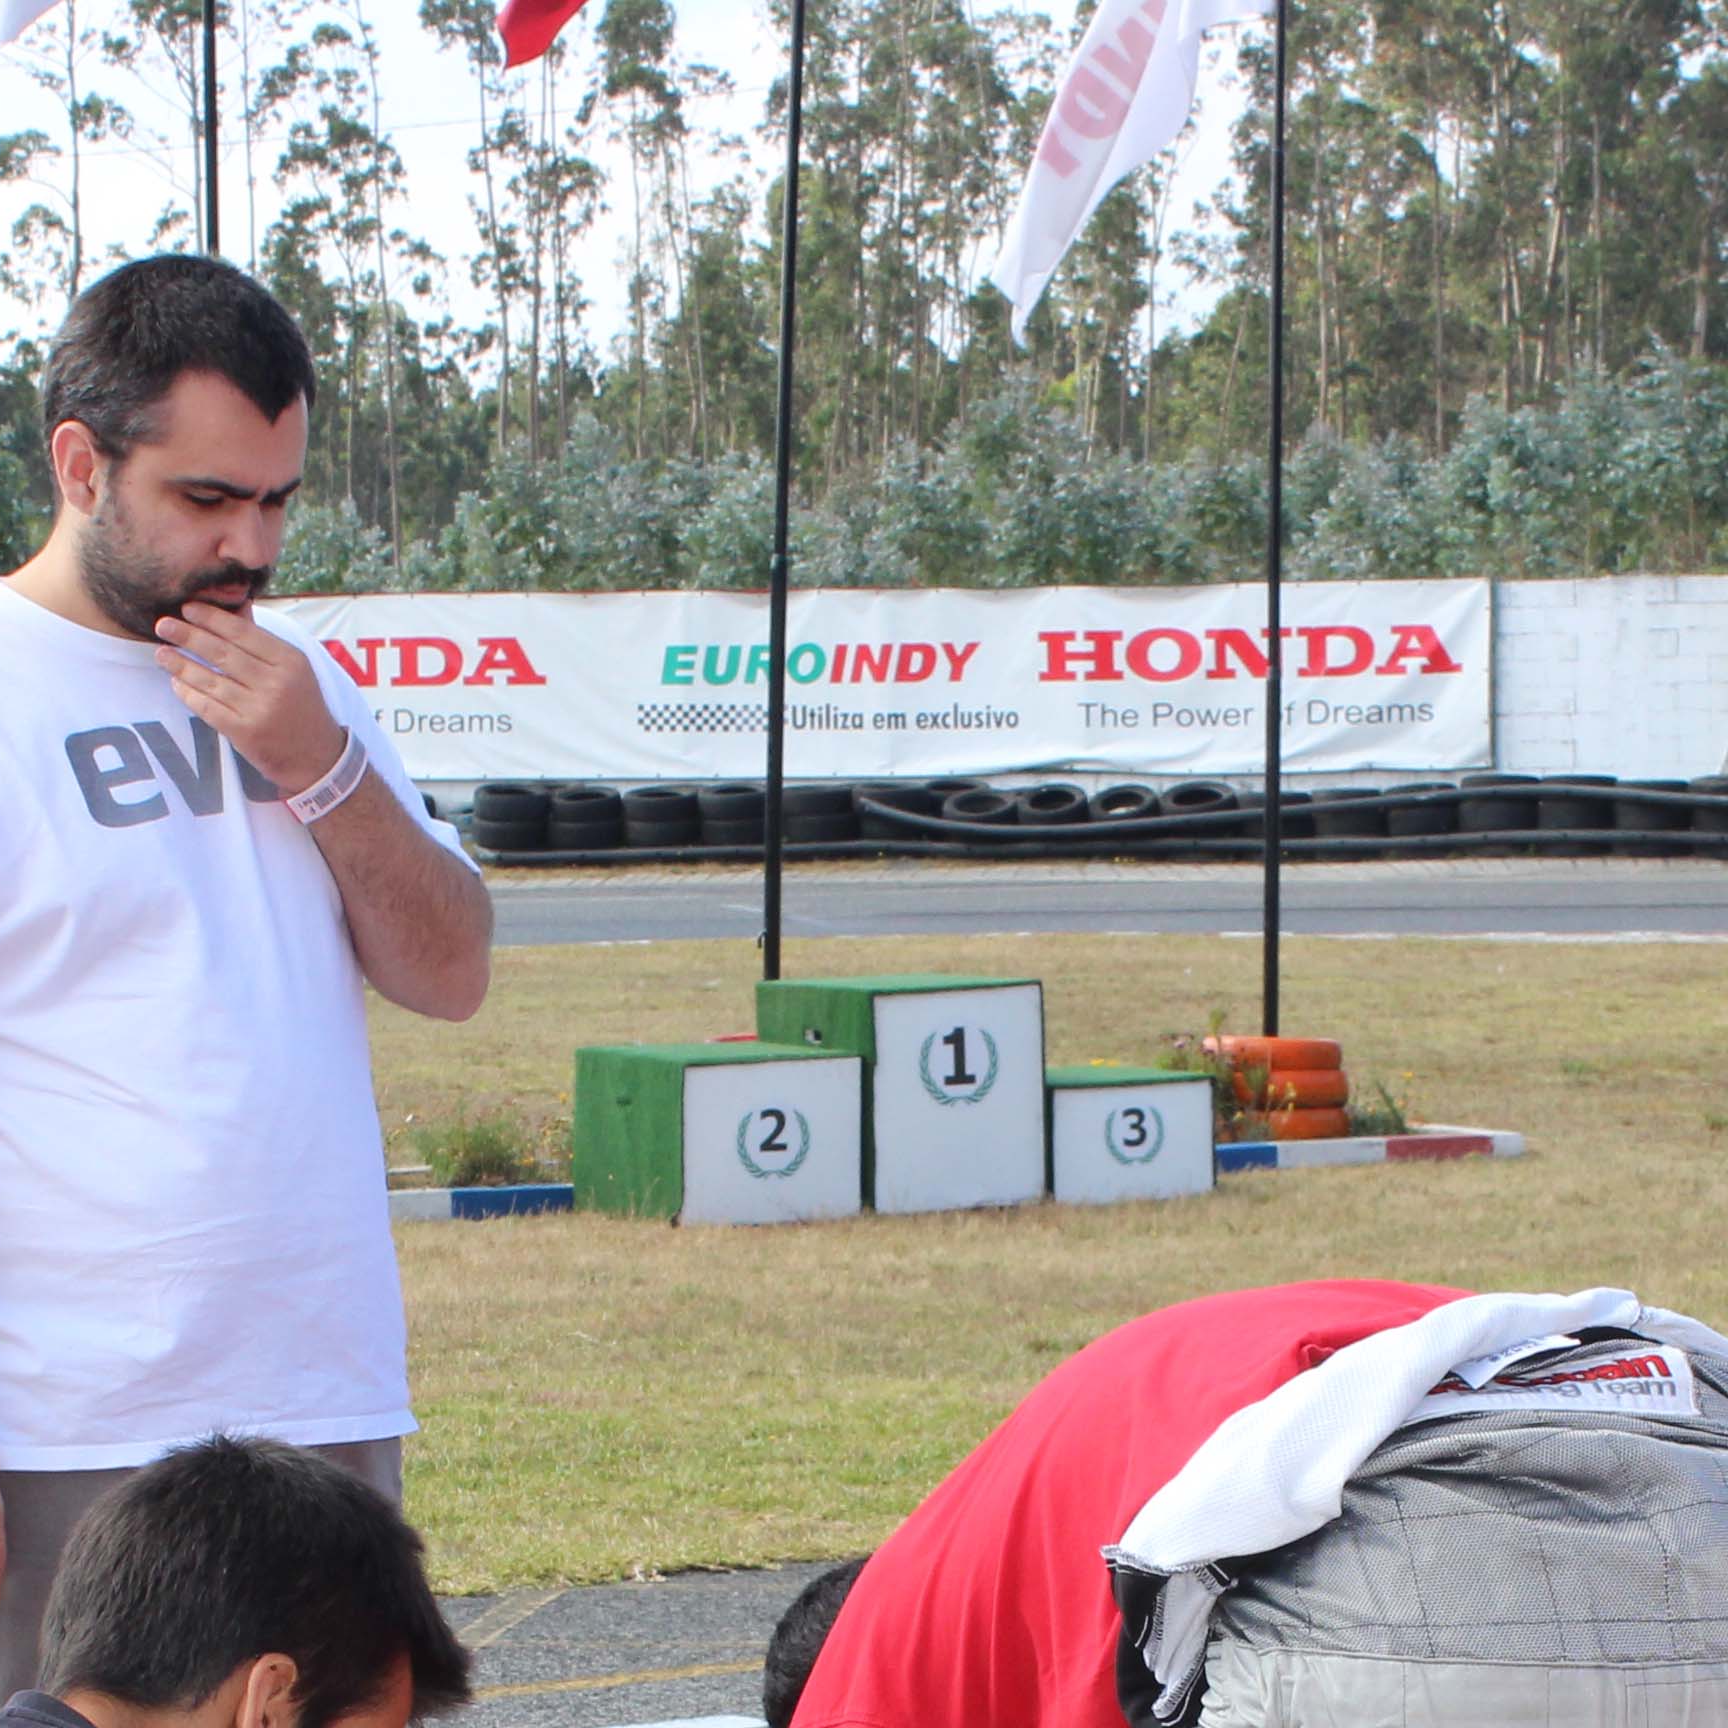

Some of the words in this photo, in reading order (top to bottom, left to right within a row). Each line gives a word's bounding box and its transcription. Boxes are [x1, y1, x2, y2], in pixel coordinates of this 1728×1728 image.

[1038, 625, 1463, 682] HONDA
[393, 709, 513, 733] Dreams
[791, 703, 864, 730] Utiliza
[872, 711, 907, 730] em
[916, 702, 1020, 729] exclusivo
[1078, 703, 1139, 728] The
[1152, 702, 1253, 728] Power
[1307, 699, 1435, 725] Dreams
[942, 1026, 977, 1087] 1
[758, 1110, 788, 1152] 2
[1120, 1107, 1149, 1147] 3
